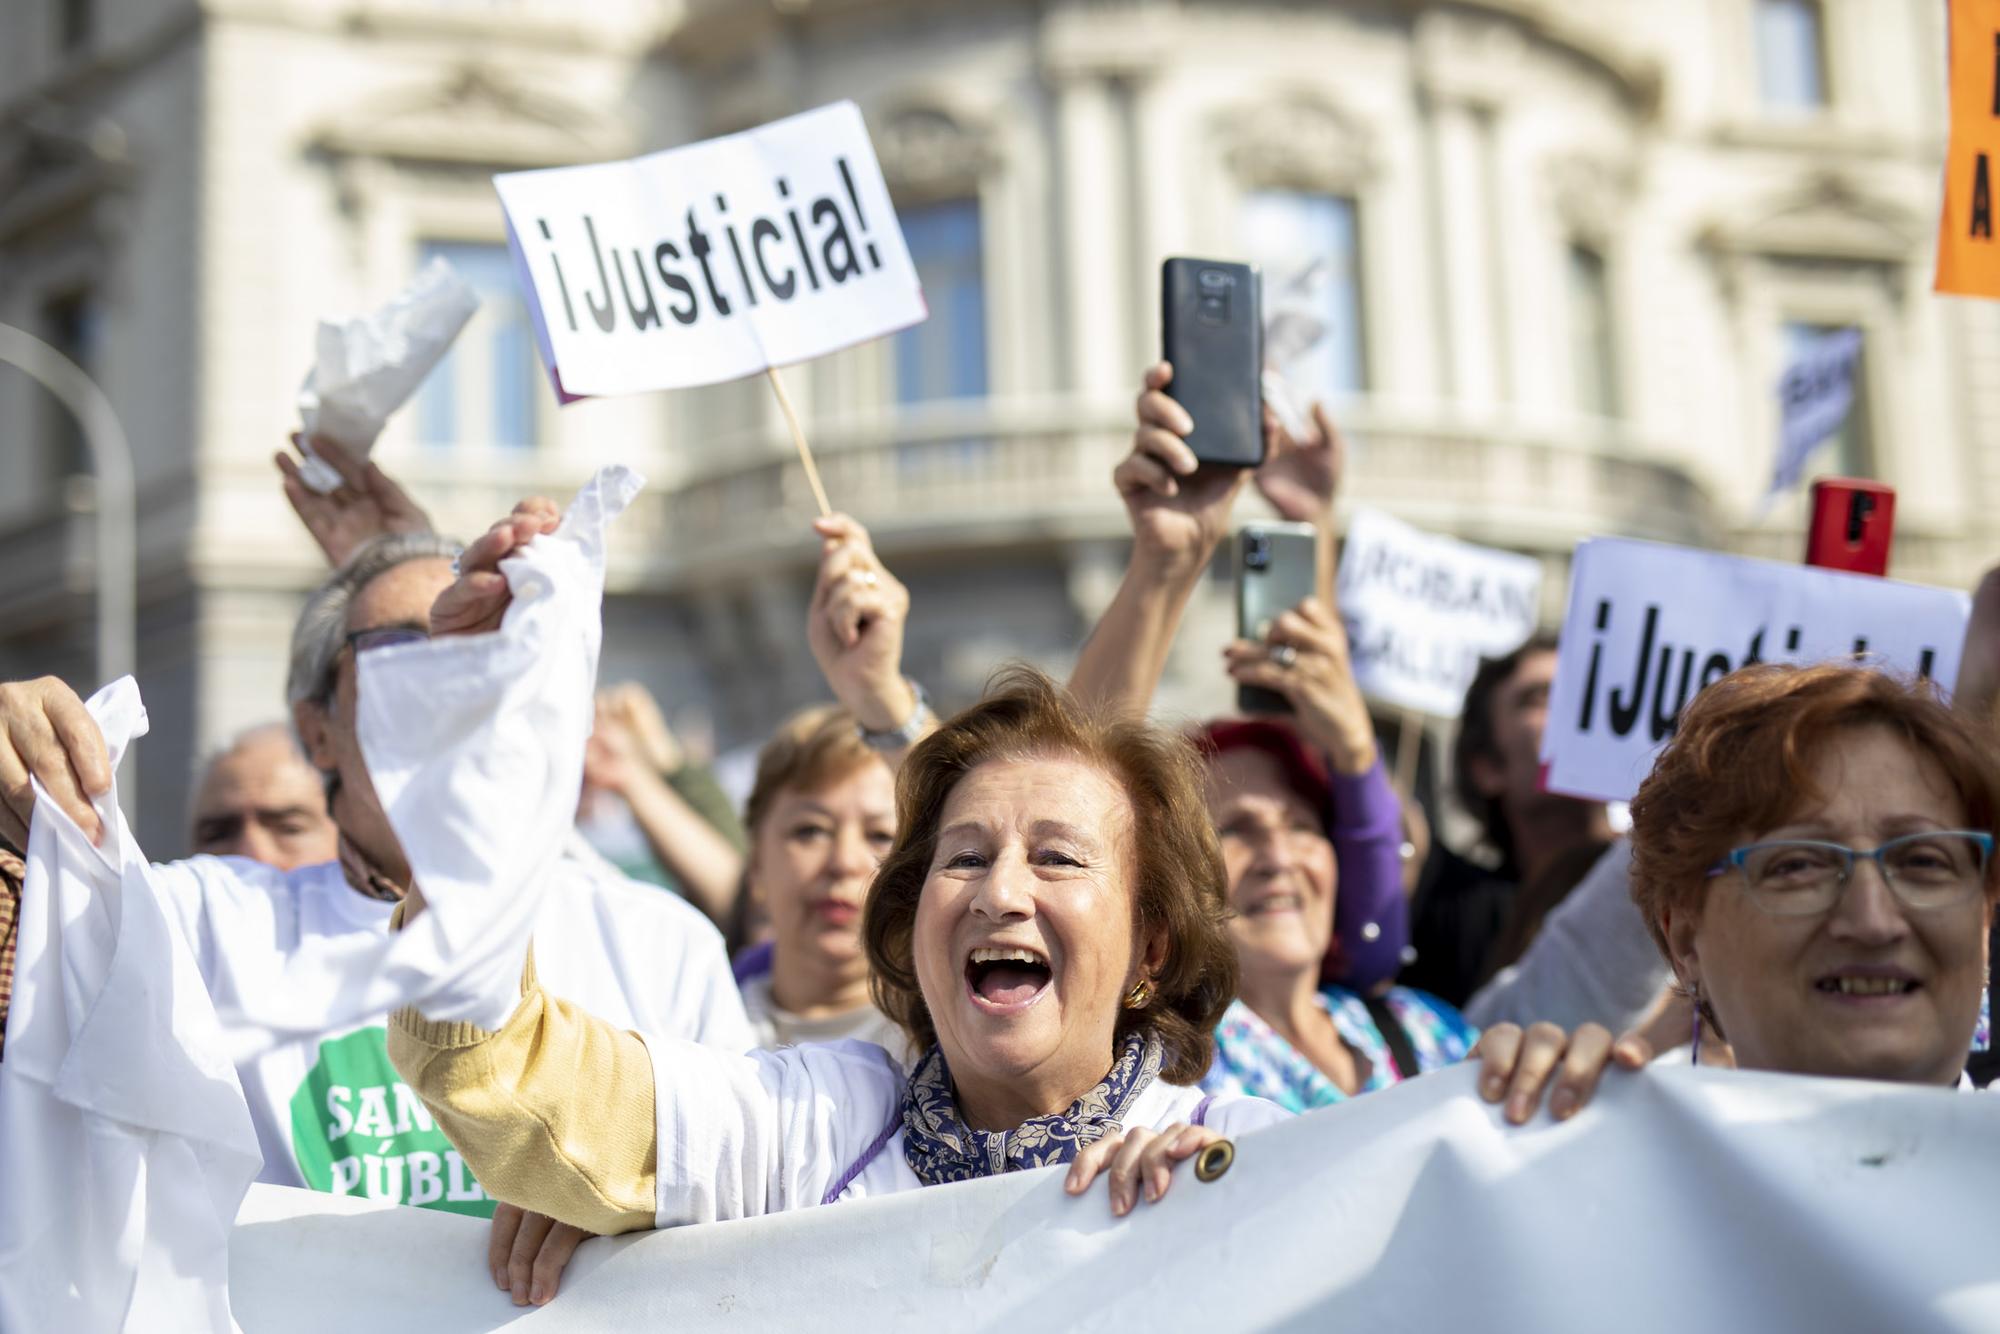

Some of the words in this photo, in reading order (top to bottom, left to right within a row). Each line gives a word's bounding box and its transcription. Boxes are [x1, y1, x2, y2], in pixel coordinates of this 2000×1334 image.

[536, 157, 883, 333] ¡Justicia!
[326, 1083, 438, 1141] SAN
[331, 1139, 488, 1207] PÚBL
